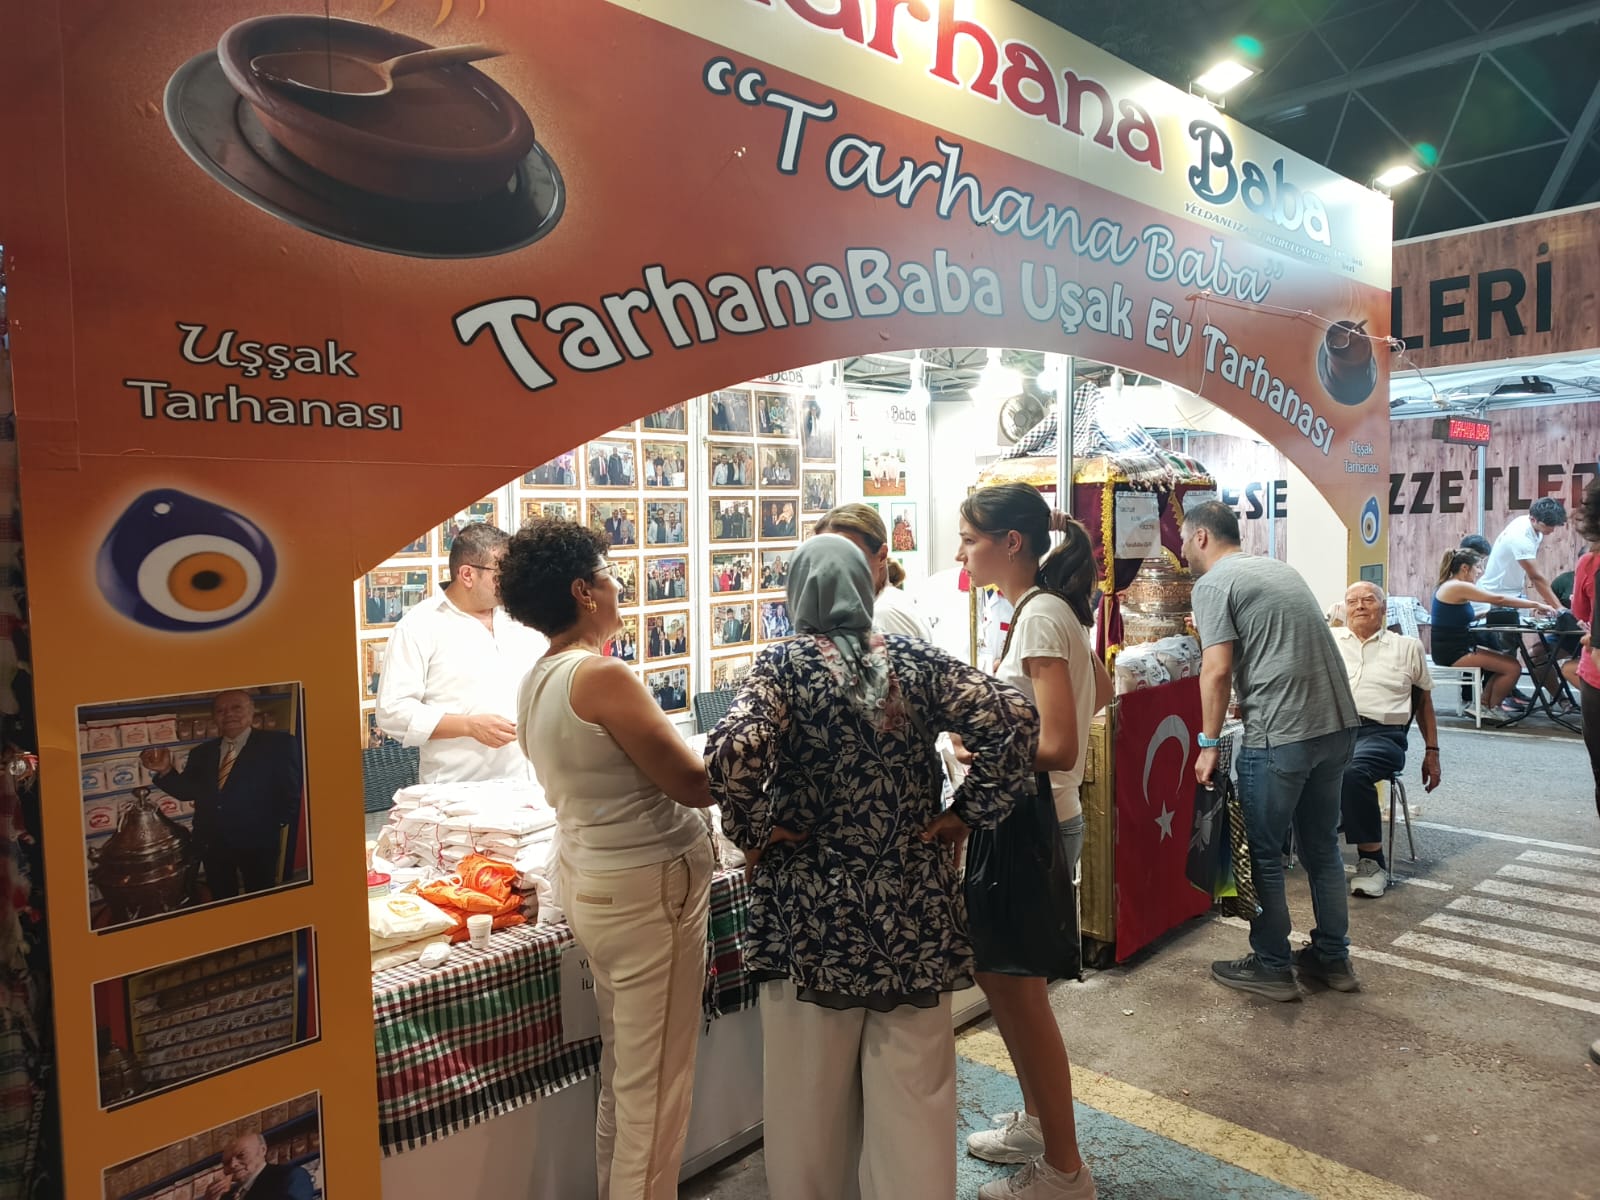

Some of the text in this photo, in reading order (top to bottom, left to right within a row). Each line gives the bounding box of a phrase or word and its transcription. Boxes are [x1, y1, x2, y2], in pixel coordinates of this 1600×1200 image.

[750, 0, 1331, 247] rhana Baba
[124, 380, 402, 430] Tarhanası
[177, 322, 358, 378] Uşşak
[453, 249, 1335, 455] TarhanaBaba Uşak Ev Tarhanası
